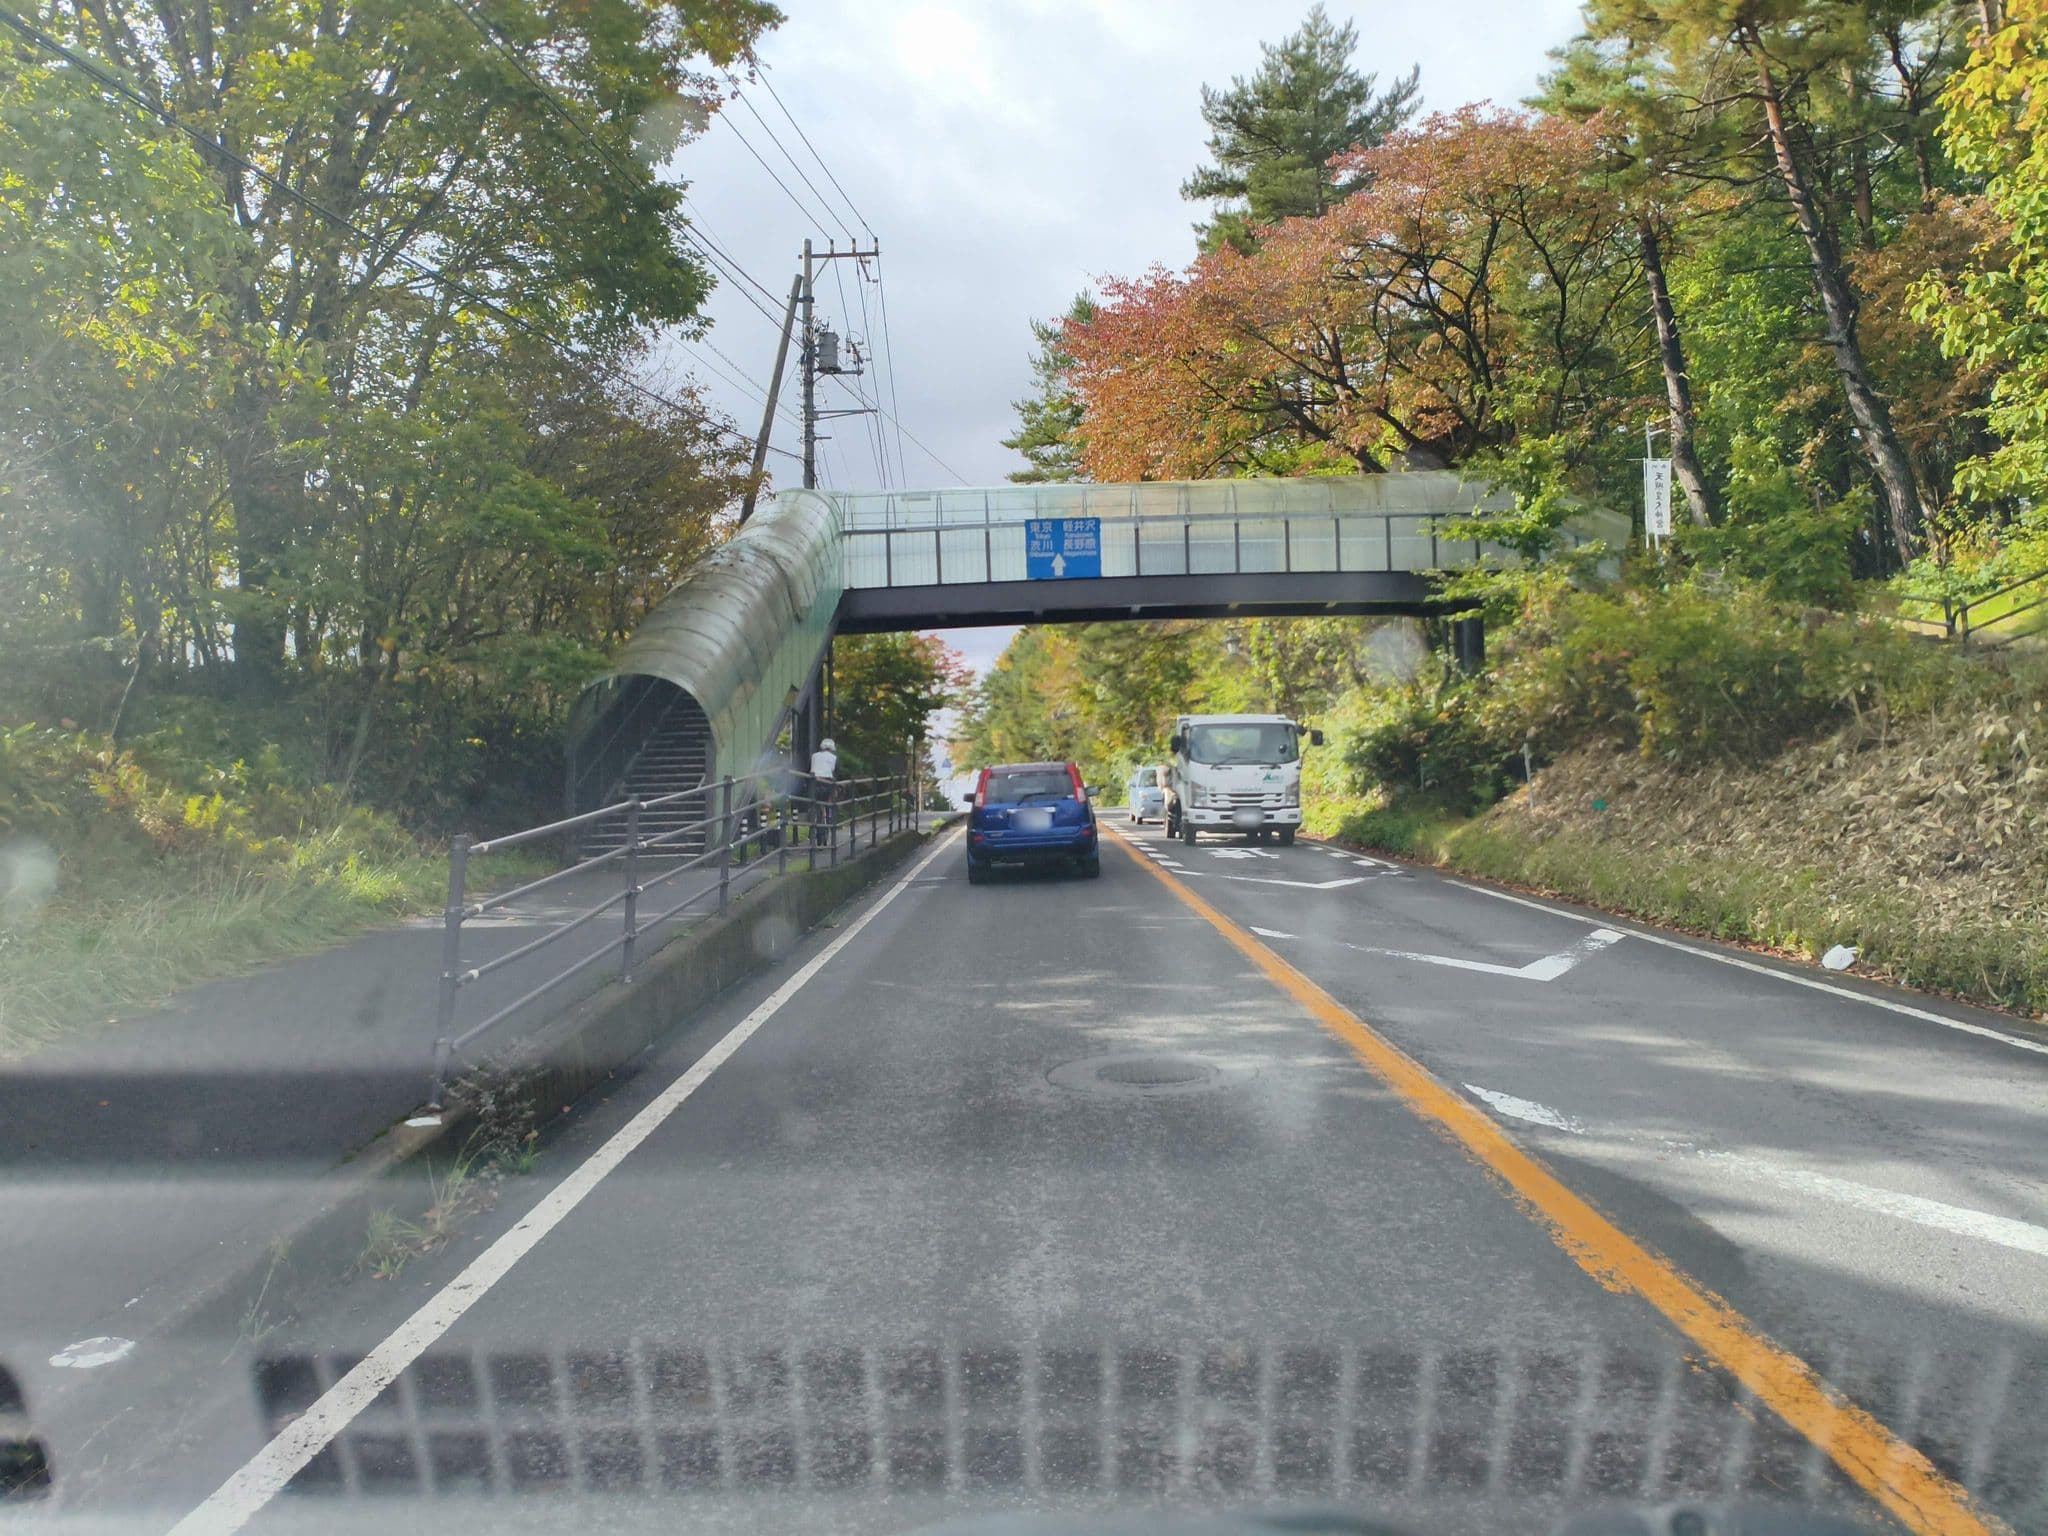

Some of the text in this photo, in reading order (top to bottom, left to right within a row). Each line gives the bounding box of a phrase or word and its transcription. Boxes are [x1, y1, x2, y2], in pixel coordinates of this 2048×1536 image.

[1029, 520, 1053, 533] 東京
[1062, 519, 1096, 532] 軽井沢
